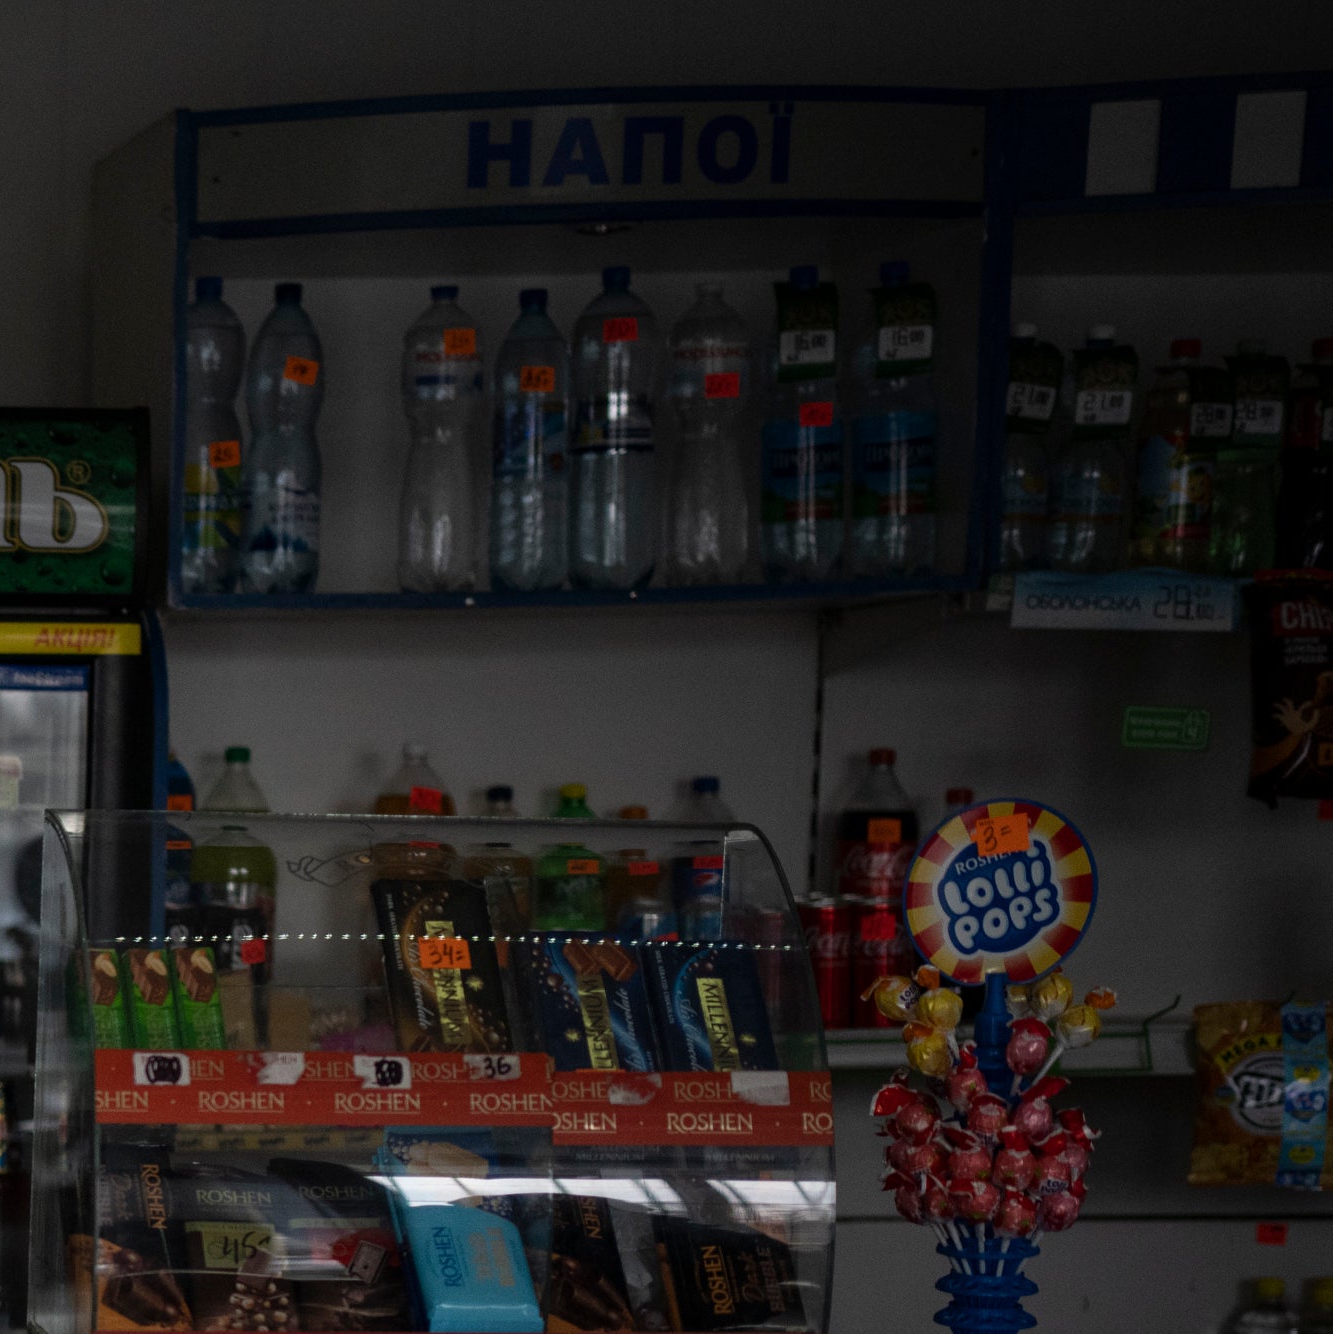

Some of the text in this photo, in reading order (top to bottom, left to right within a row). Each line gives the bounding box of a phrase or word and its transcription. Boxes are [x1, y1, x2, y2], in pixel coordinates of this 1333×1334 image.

[466, 103, 795, 189] НАПОЇ
[1026, 594, 1141, 612] ОБОЛОНСЬКА
[32, 627, 117, 650] АКЦІЯ!
[953, 887, 1054, 950] POPS
[410, 966, 435, 1030] Chocolate
[483, 1057, 512, 1080] 36
[96, 1091, 149, 1110] SHEN
[198, 1092, 285, 1112] ROSHEN
[334, 1093, 421, 1113] ROSHEN
[667, 1112, 753, 1133] ROSHEN
[139, 1163, 168, 1230] ROSHEN
[196, 1189, 272, 1206] ROSHEN
[298, 1185, 375, 1200] ROSHEN
[580, 1196, 603, 1239] SHEN
[432, 1226, 462, 1288] ROSHEN
[701, 1245, 733, 1315] ROSHEN
[737, 1250, 763, 1303] Dark
[757, 1246, 785, 1312] BUBBLE
